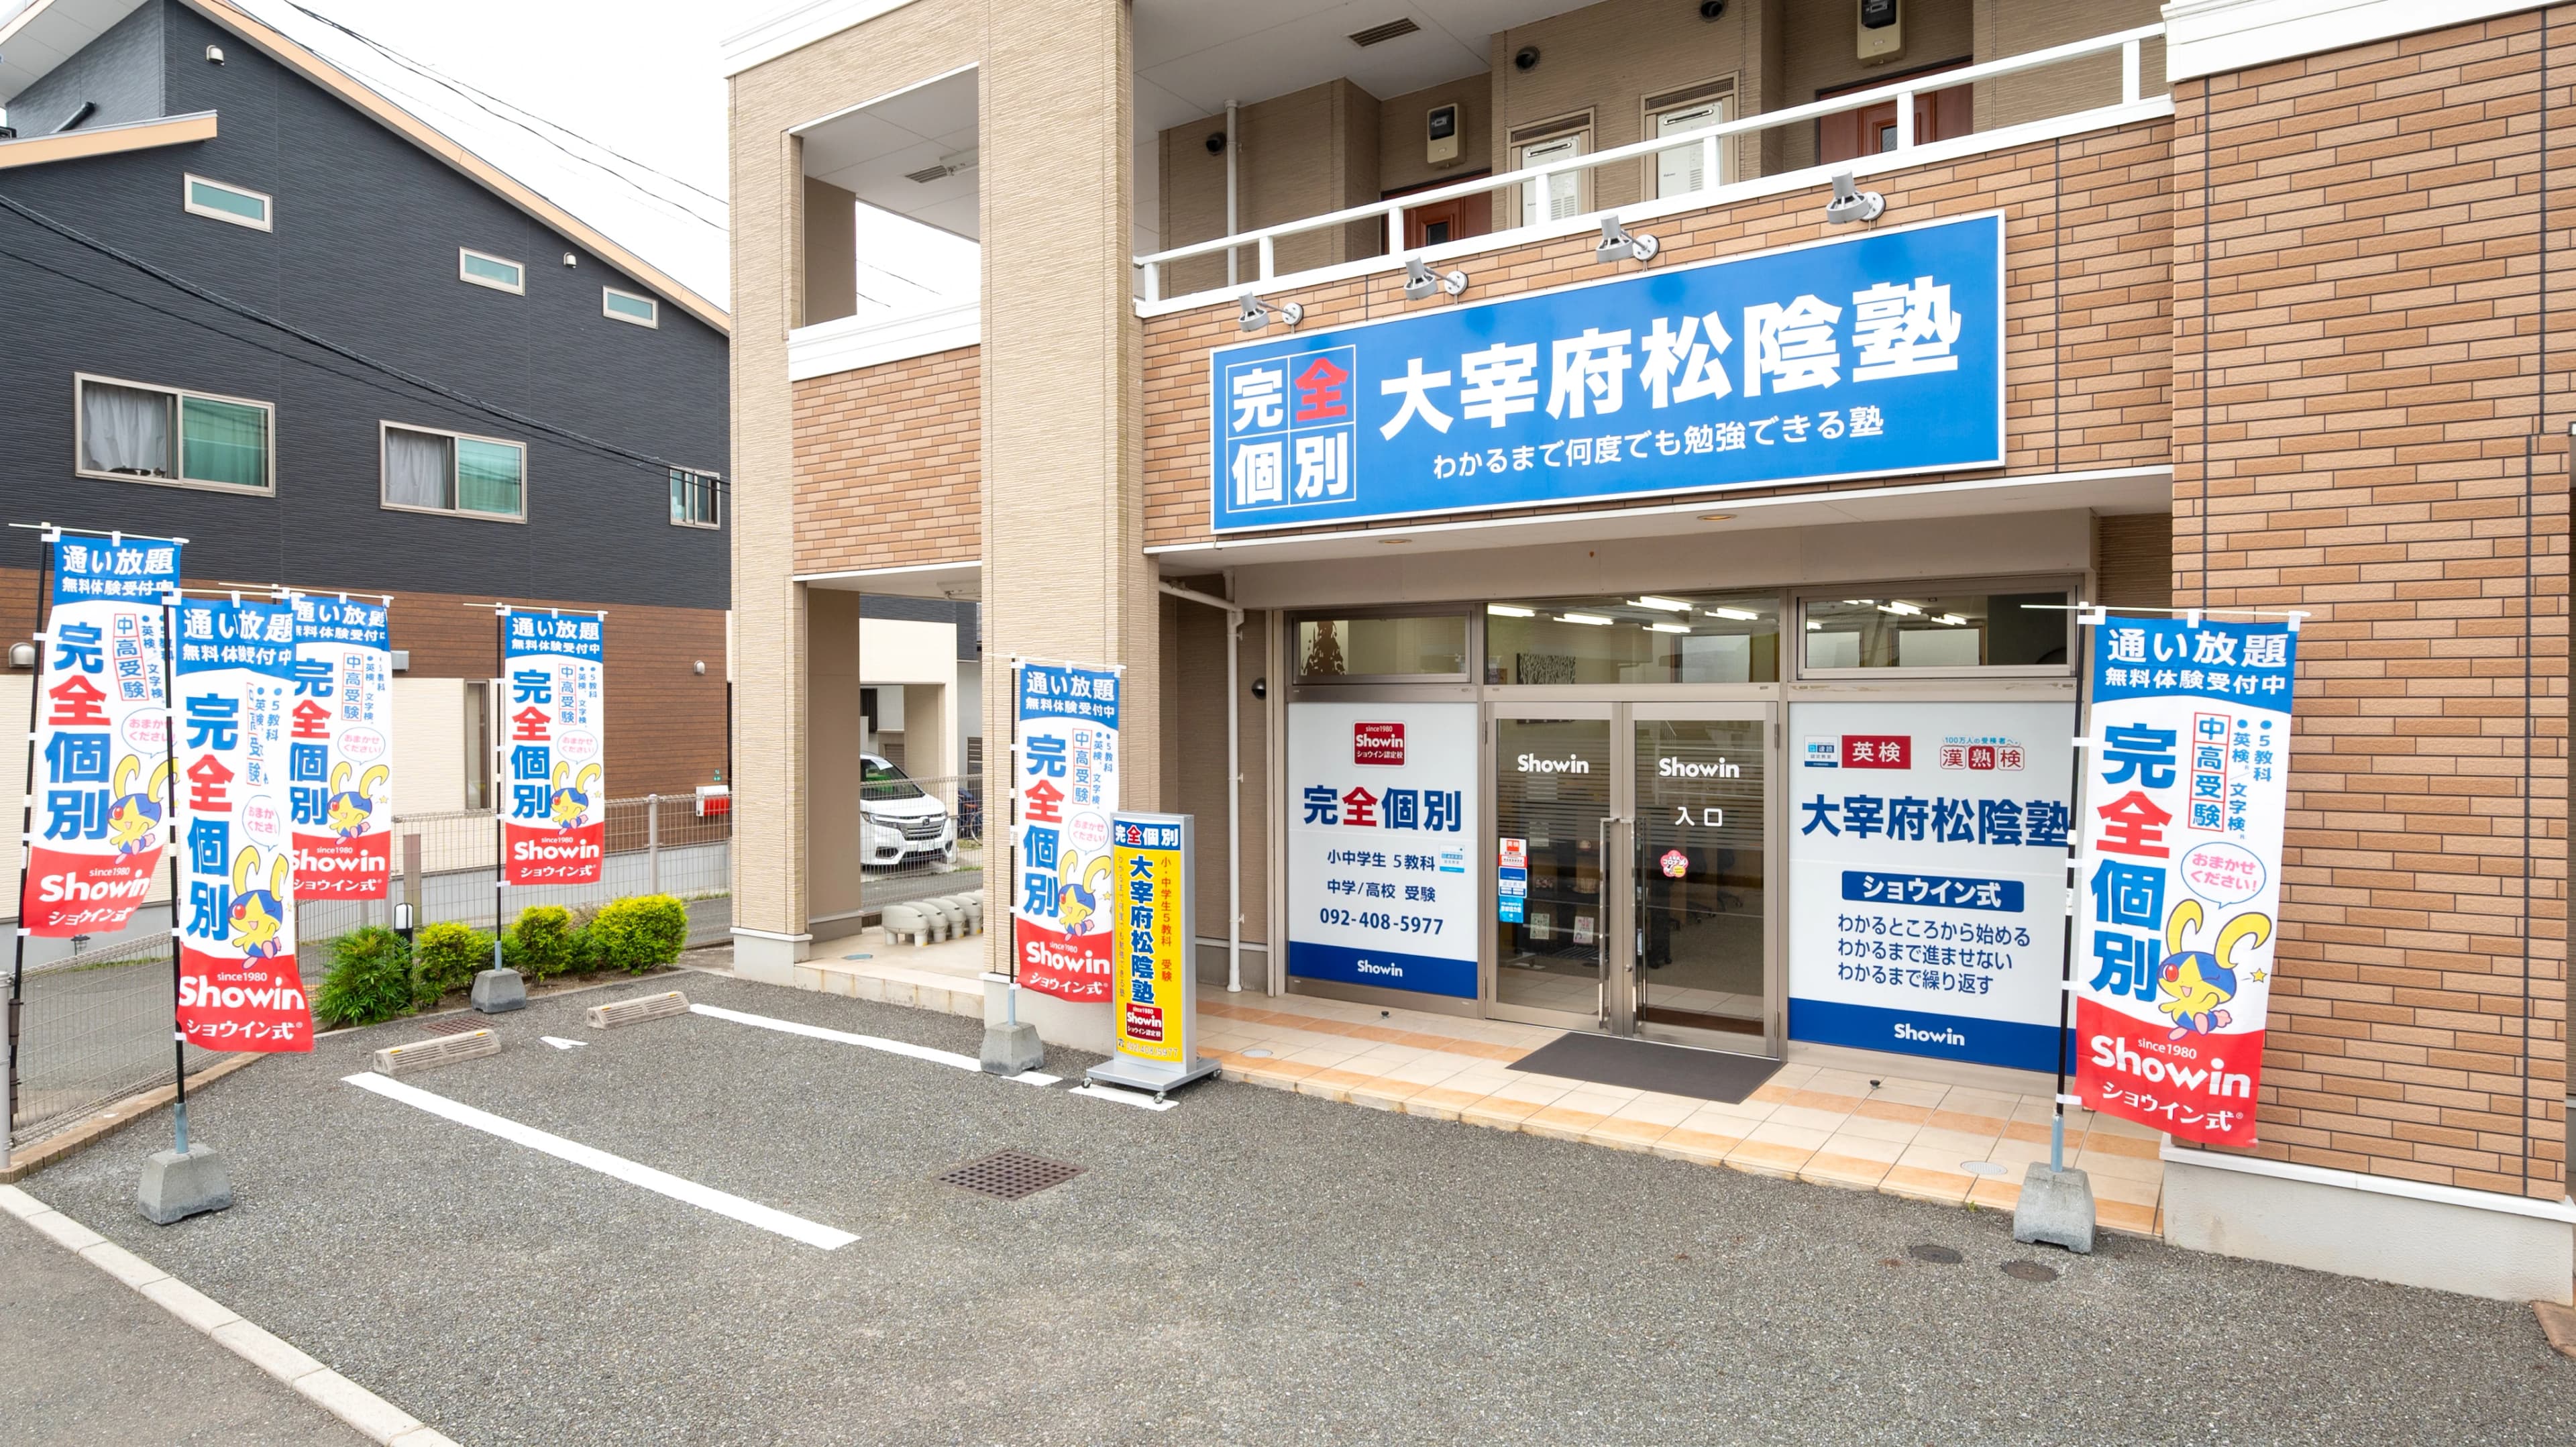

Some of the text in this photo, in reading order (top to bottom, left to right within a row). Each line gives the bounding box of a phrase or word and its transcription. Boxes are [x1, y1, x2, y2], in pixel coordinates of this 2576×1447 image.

[1379, 275, 1962, 441] 大宰府松陰塾
[1232, 357, 1349, 433] 完全
[1433, 405, 1884, 479] わかるまで何度でも勉強できる塾
[1232, 431, 1348, 506] 個別
[62, 545, 175, 576] 通い放題
[183, 608, 293, 643] 通い放題
[512, 617, 600, 641] 通い放題
[115, 617, 146, 698] 中高受験
[511, 639, 600, 654] 無料体験受付中
[2107, 628, 2289, 668] 通い放題
[343, 655, 362, 720] 中高受験
[561, 665, 575, 724] 中高受験
[588, 674, 598, 698] 5教科
[1026, 672, 1115, 701] 通い放題
[2105, 667, 2286, 695] 無料体験受付中
[266, 700, 280, 741] 5教科
[1026, 696, 1115, 718] 無料体験受付中
[44, 621, 112, 841] 完全個別
[129, 718, 174, 729] おまか
[290, 658, 333, 826] 完全個別
[343, 735, 380, 745] おまかせ
[511, 669, 551, 818] 完全個別
[1356, 733, 1403, 747] Showin
[1852, 742, 1901, 763] 英検
[1075, 731, 1089, 803] 中高受験
[1104, 743, 1114, 773] 5教科
[1517, 753, 1589, 773] Showin
[1659, 757, 1740, 778] Showin
[2192, 716, 2226, 828] 中高受験
[2253, 735, 2273, 782] 5教科
[186, 693, 239, 941] 完全個別
[1303, 785, 1461, 832] 完全個別
[1675, 806, 1723, 826] 入口
[1802, 794, 2071, 848] 大宰府松陰塾
[1023, 734, 1067, 918] 完全個別
[1073, 818, 1104, 833] おまかせ
[1115, 824, 1179, 847] 完全個別
[292, 849, 386, 872] Showin
[514, 839, 600, 861] Showin
[1327, 849, 1387, 867] 小中学生
[1393, 854, 1436, 871] 5教科
[2090, 722, 2177, 1002] 完全個別
[2191, 852, 2257, 875] おまかせ
[40, 869, 150, 903] Showin
[89, 867, 130, 877] since1980
[2190, 869, 2258, 892] ください!
[1405, 886, 1436, 902] 受験
[1863, 874, 2002, 908] ショウイン式
[1130, 855, 1155, 1004] 大宰府松陰塾
[1320, 908, 1444, 935] 092-408-5977
[1838, 913, 2031, 947] わかるところから始める
[1026, 941, 1110, 975] Showin
[1049, 941, 1078, 953] since1980
[1838, 938, 2012, 970] わかるまで進ませない
[217, 972, 268, 982] since1980
[1357, 959, 1403, 977] Showin
[1838, 962, 1994, 995] わかるまで繰り返す
[179, 976, 305, 1010] Showin
[1127, 1012, 1162, 1028] Showin
[1894, 1023, 1966, 1047] Showin
[2138, 1038, 2197, 1060] since1980
[2090, 1035, 2251, 1098] Showin
